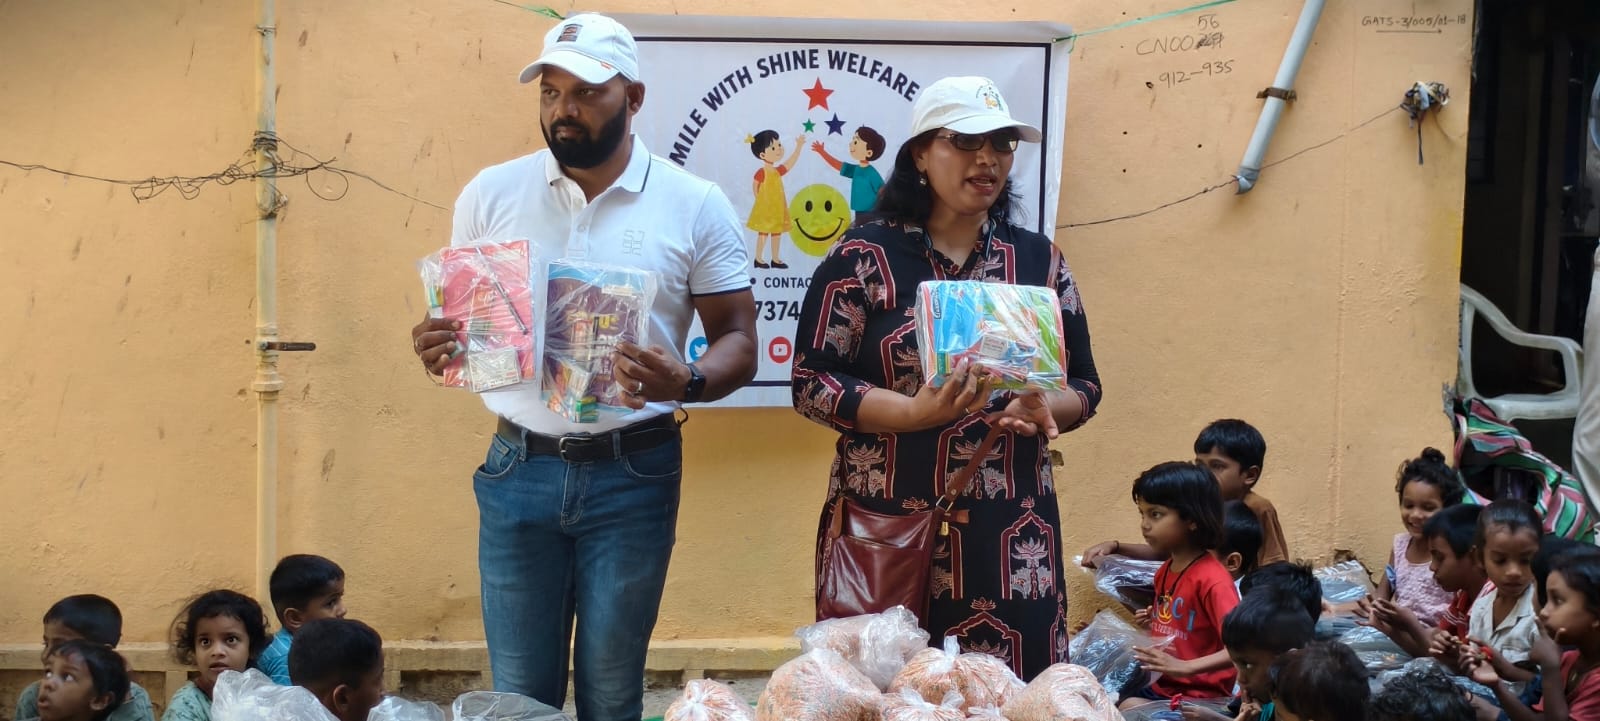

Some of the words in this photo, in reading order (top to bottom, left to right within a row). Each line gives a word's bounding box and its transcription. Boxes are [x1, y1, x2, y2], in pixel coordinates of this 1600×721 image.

[1198, 13, 1220, 30] 56
[701, 65, 754, 112] WITH
[756, 48, 820, 79] SHINE
[827, 49, 920, 103] WELFARE
